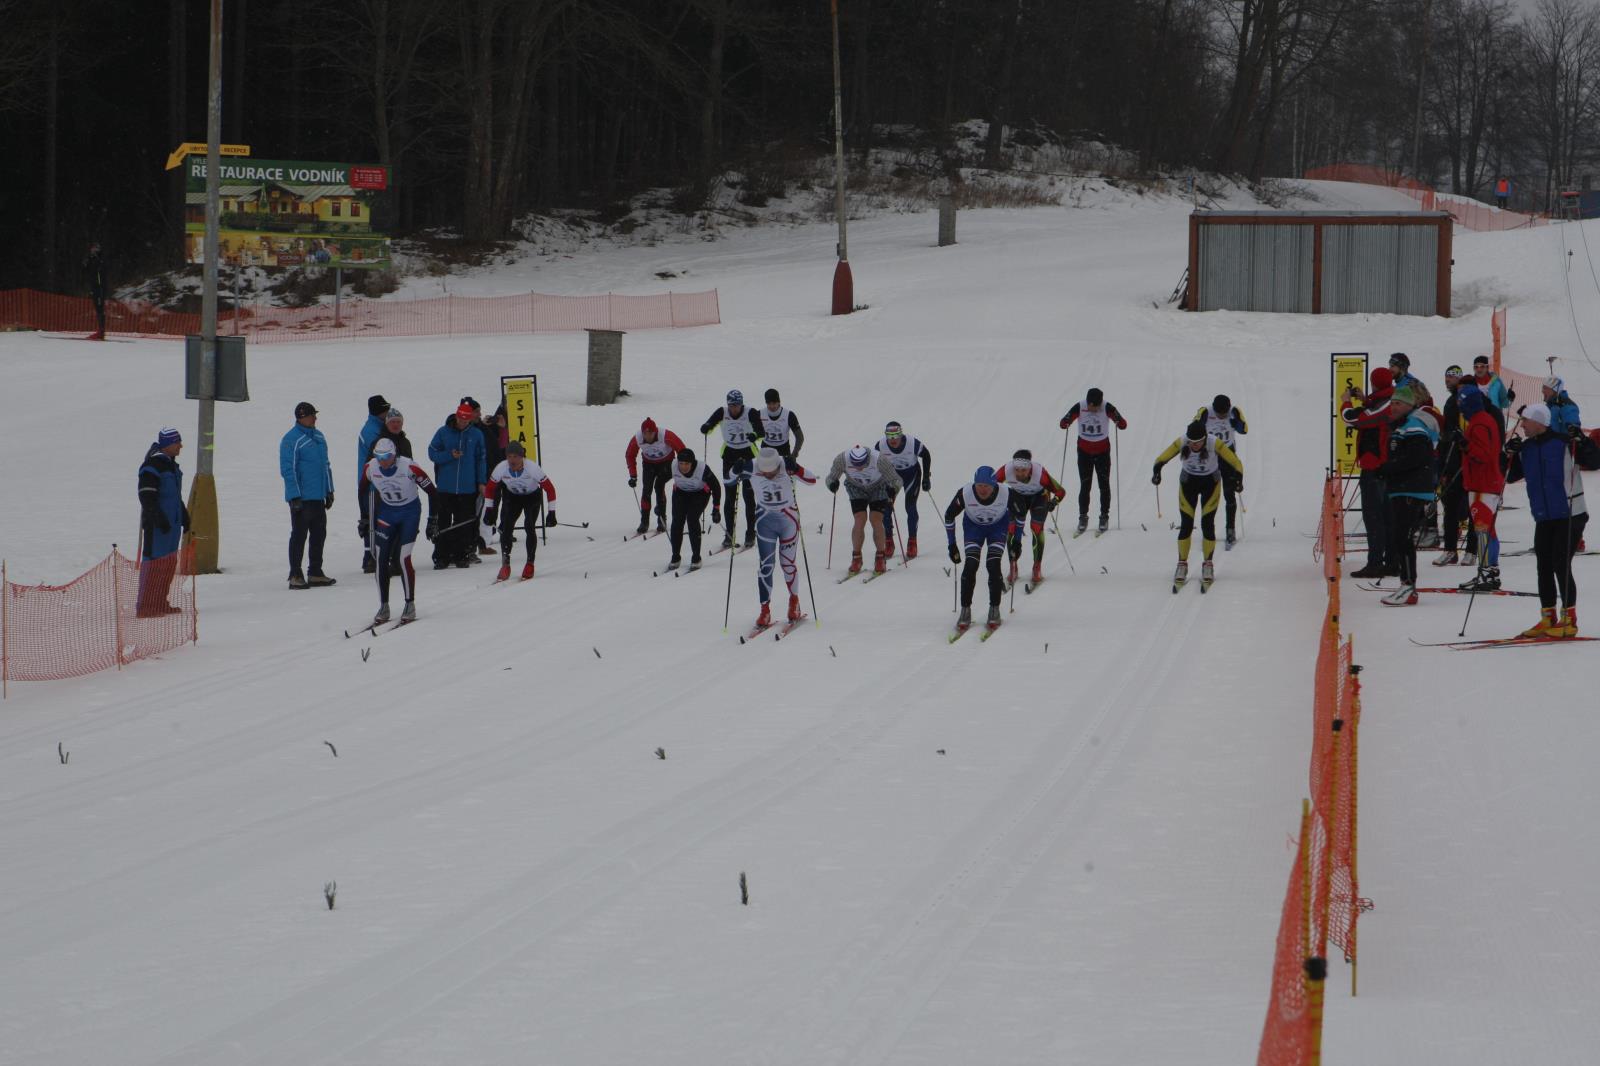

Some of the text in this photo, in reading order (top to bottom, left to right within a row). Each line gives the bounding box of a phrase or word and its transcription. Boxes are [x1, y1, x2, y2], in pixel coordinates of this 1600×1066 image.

[191, 164, 284, 181] RETAURACE
[288, 167, 346, 183] VODNÍK
[1081, 424, 1102, 434] 141
[728, 432, 745, 442] 71
[383, 491, 402, 500] 11
[762, 490, 783, 501] 31
